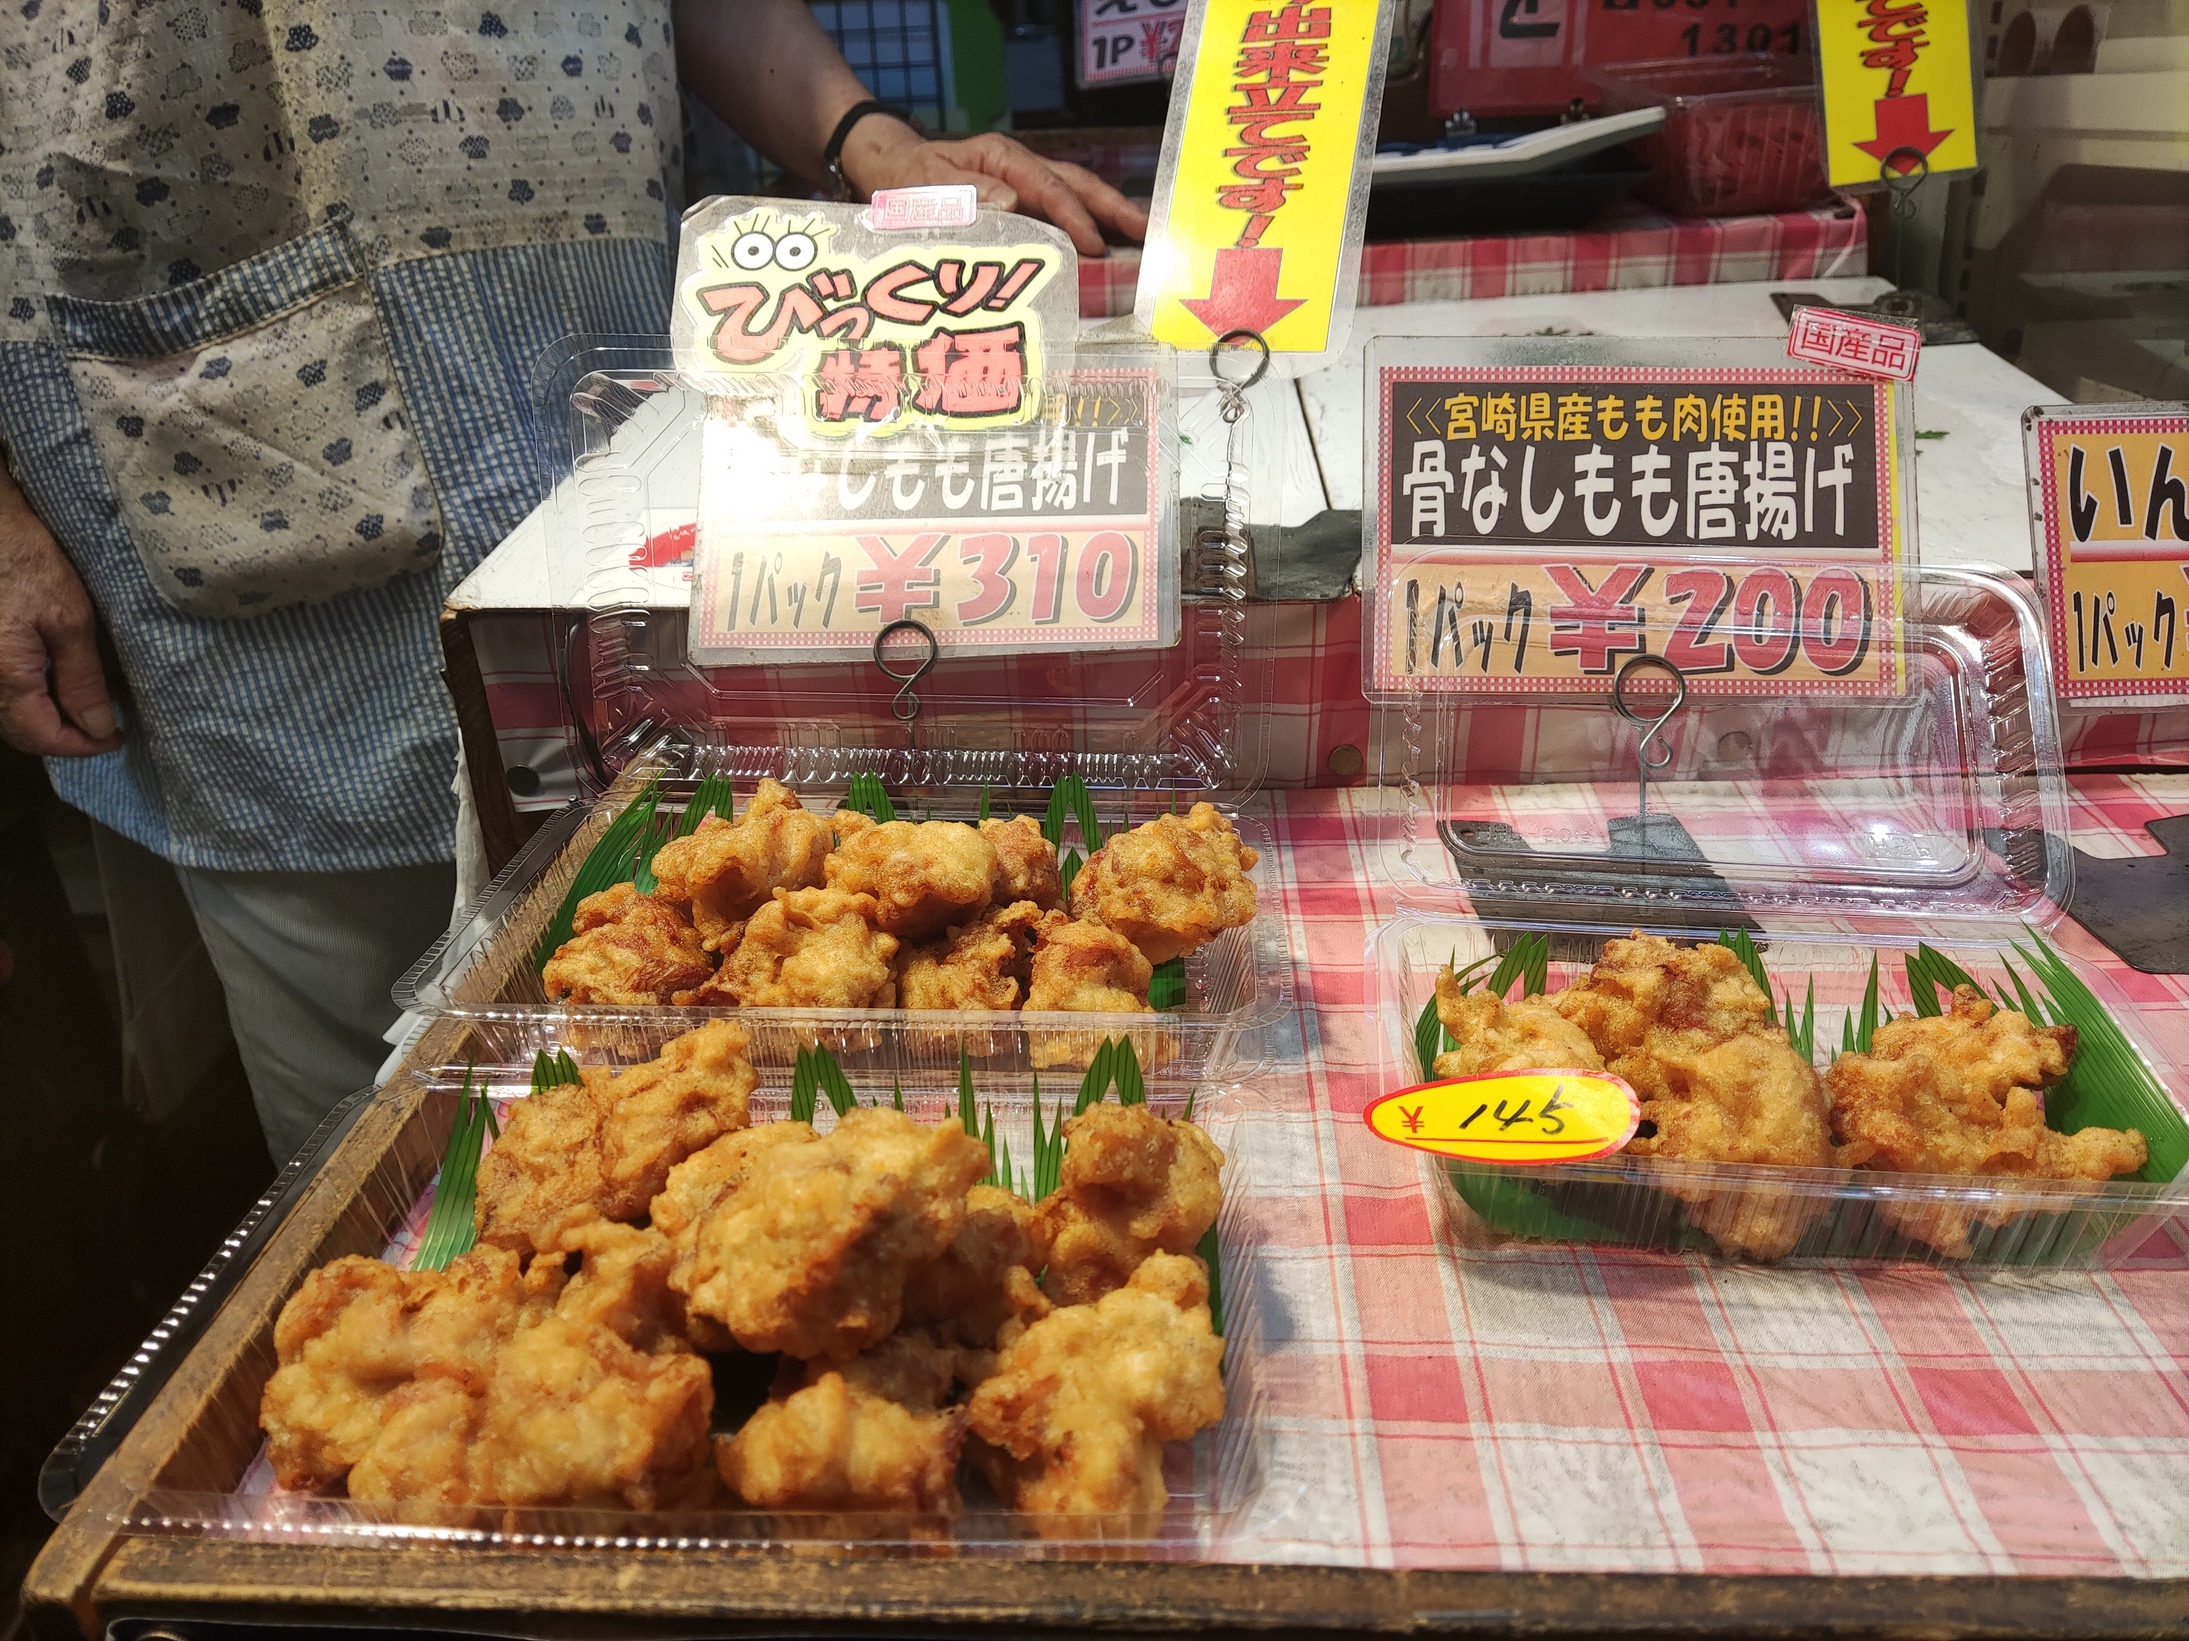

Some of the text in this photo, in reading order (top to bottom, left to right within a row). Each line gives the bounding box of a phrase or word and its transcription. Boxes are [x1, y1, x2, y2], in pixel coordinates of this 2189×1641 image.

[1217, 0, 1332, 248] 出来立てです!
[884, 195, 964, 222] 国産品
[815, 321, 1026, 423] 特価
[1800, 319, 1907, 371] 国産品
[1402, 438, 1854, 541] 骨なしもも唐揚げ
[727, 531, 1138, 632] 1パック ¥310
[1405, 563, 1872, 676] 1パック ¥200
[1458, 1084, 1575, 1136] 145
